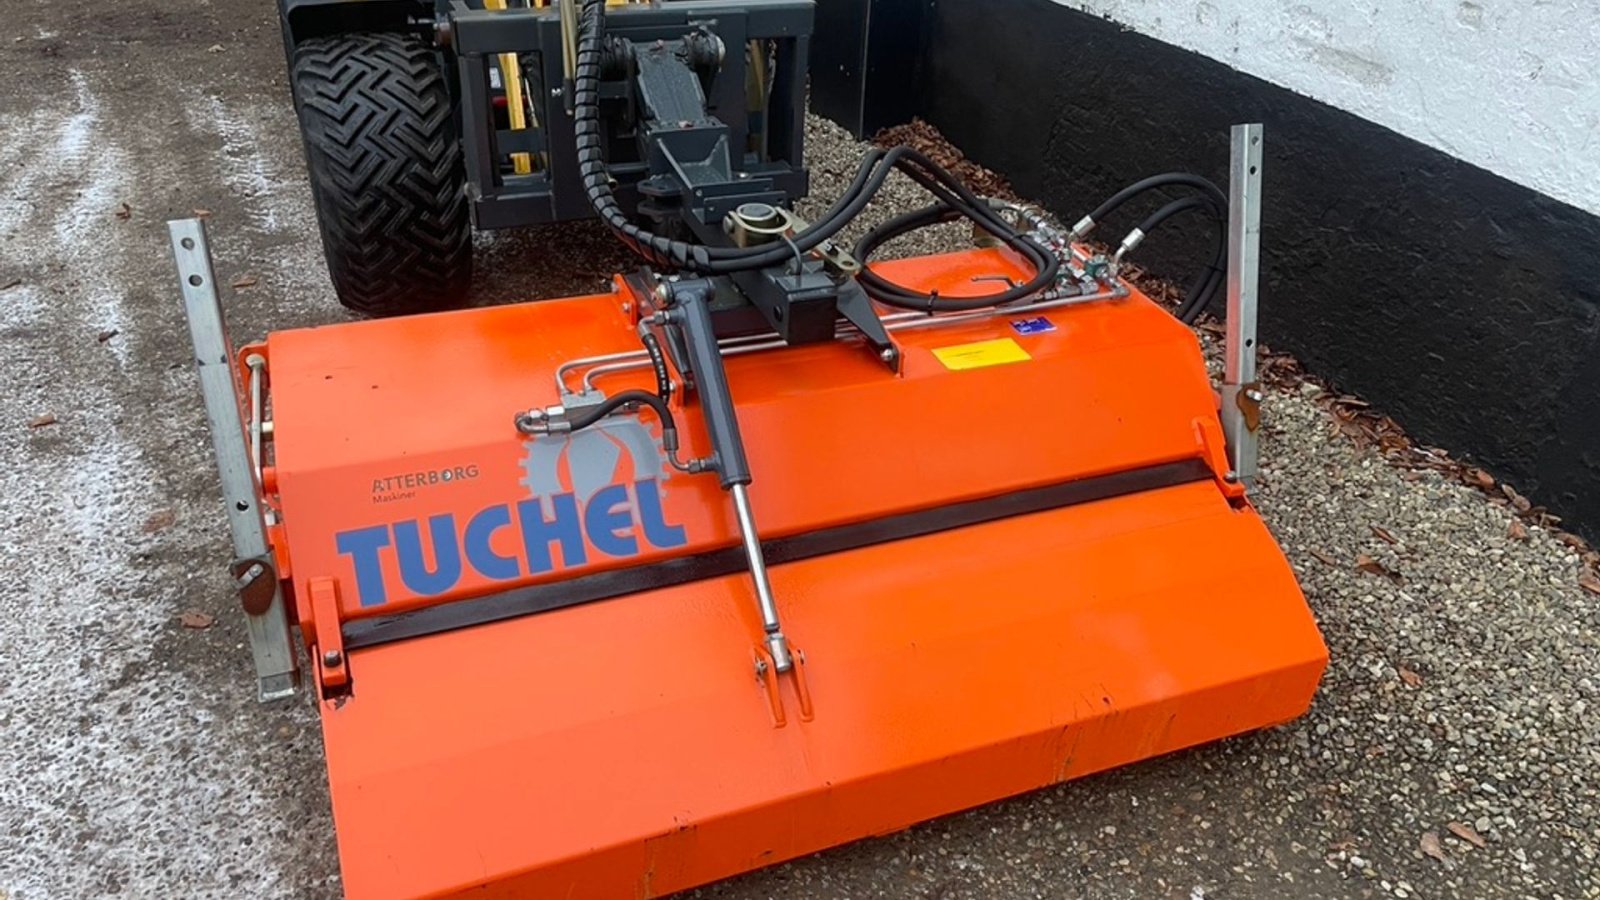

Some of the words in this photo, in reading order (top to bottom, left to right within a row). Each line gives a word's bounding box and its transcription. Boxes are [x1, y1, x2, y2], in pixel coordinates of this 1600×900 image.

[372, 465, 479, 492] ATTERBORG
[373, 490, 416, 503] Maskiner
[335, 478, 687, 607] TUCHEL
